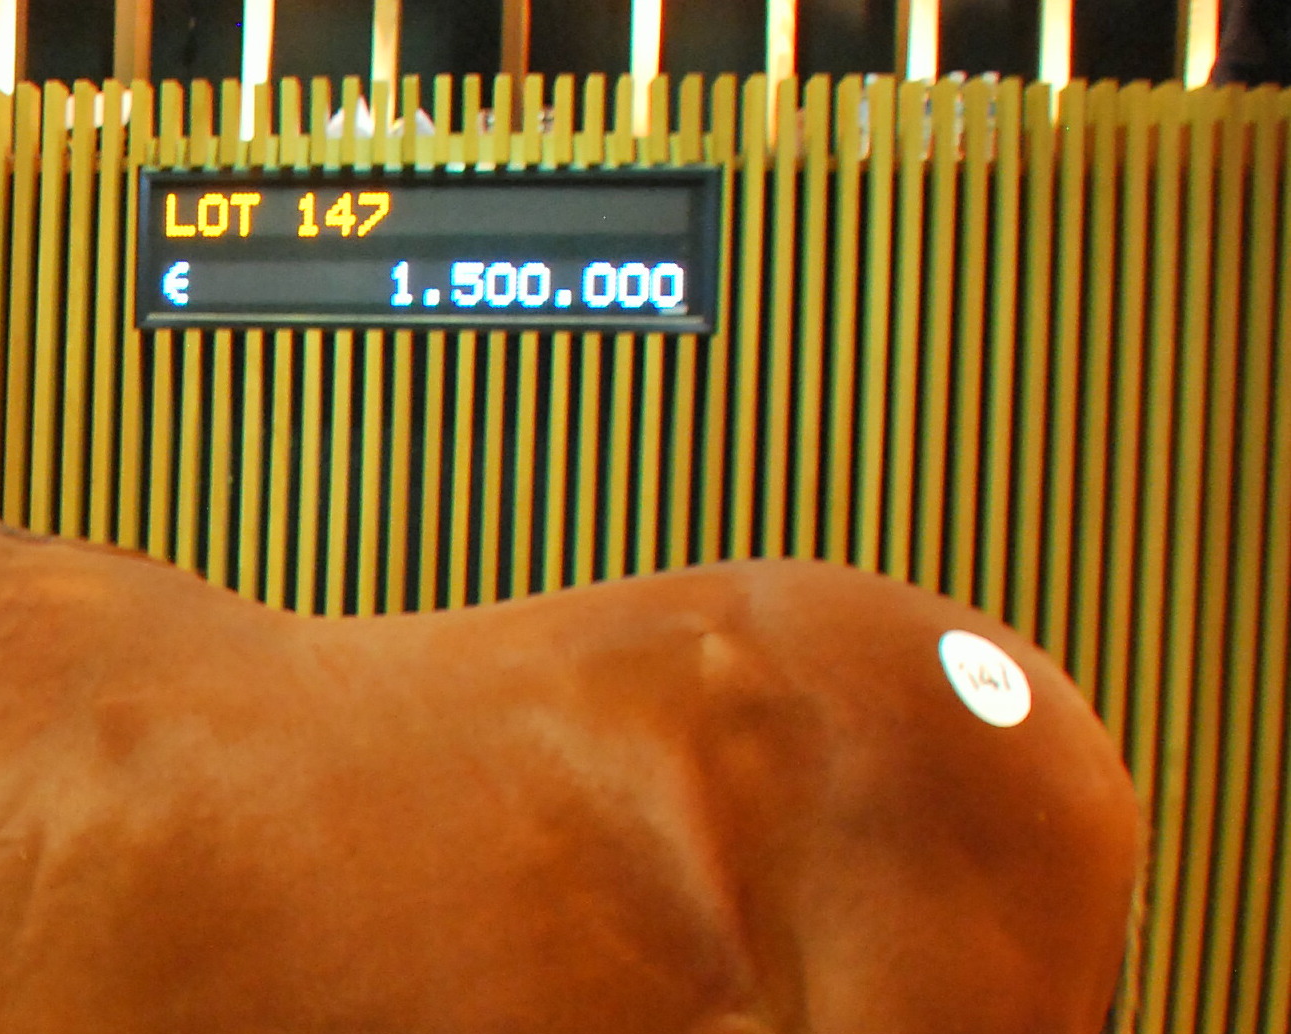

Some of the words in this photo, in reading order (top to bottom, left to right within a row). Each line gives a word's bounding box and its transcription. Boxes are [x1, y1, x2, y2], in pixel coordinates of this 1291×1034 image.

[165, 192, 261, 237] LOT
[297, 192, 391, 237] 147
[162, 260, 190, 306] €
[390, 260, 685, 308] 1.500.000
